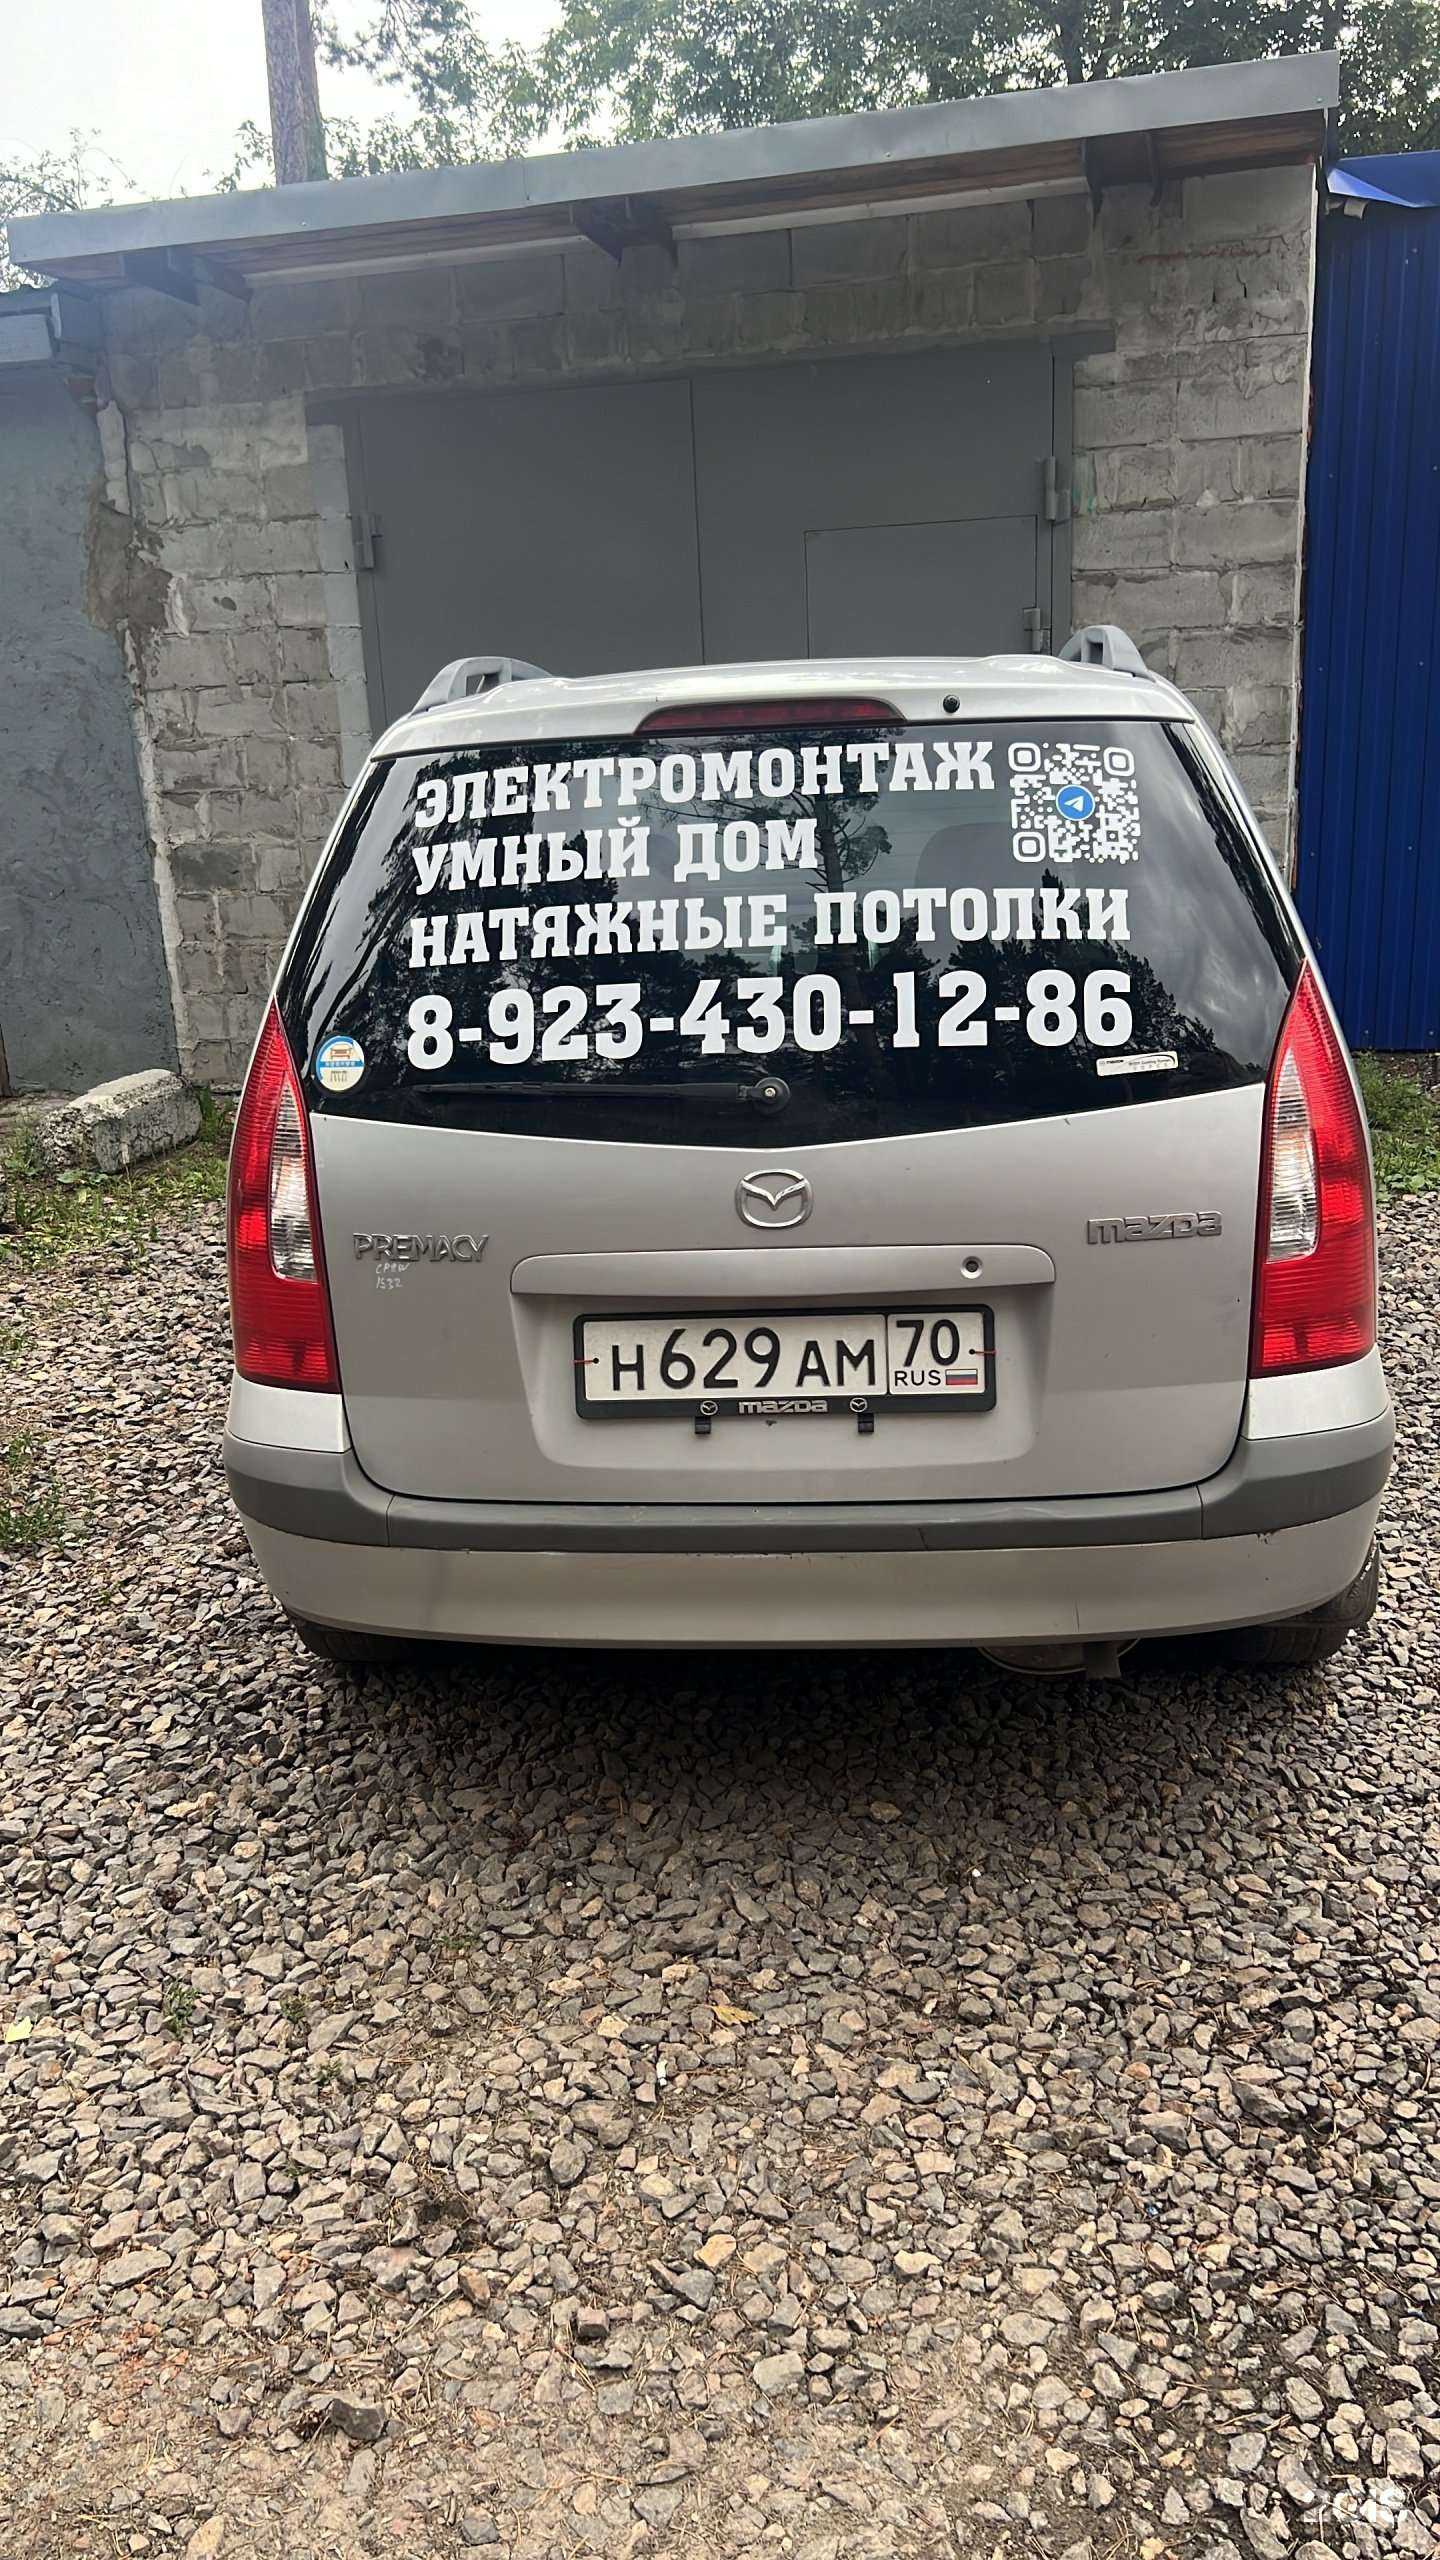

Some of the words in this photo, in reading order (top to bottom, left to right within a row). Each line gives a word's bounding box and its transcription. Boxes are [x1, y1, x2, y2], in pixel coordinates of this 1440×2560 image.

[414, 741, 995, 828] ЭЛЕКТРОМОНТАЖ
[412, 816, 651, 896] УМНЫЙ
[674, 818, 818, 883] ДОМ
[409, 893, 788, 969] НАТЯЖНЫЕ
[814, 887, 1131, 945] ПОТОЛКИ
[407, 969, 1133, 1070] 8-923-430-12-86
[353, 1232, 489, 1262] PREMACY
[895, 1318, 961, 1368] 70
[738, 1399, 829, 1415] mazda
[893, 1369, 942, 1386] RUS
